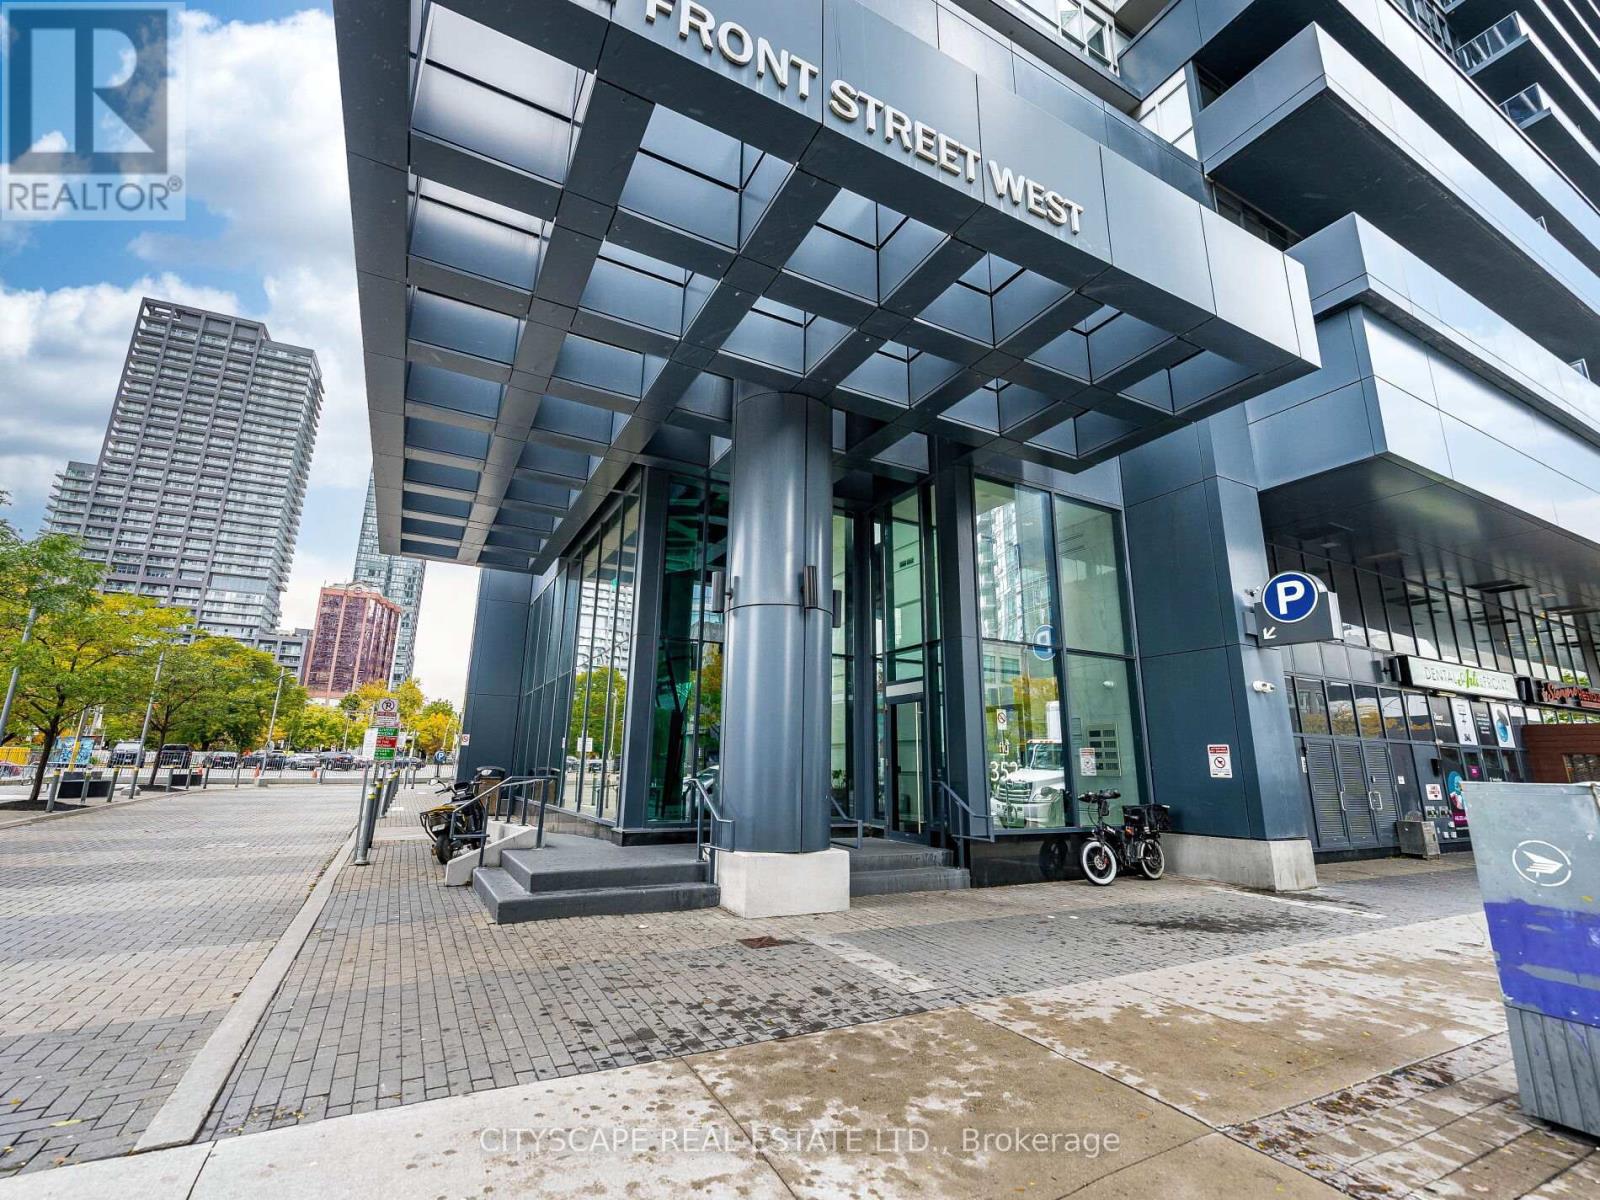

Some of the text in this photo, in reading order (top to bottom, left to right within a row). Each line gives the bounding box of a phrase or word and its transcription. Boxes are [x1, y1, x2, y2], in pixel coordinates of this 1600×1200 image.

[829, 78, 982, 184] STREET
[988, 159, 1085, 236] WEST
[1276, 579, 1305, 615] P
